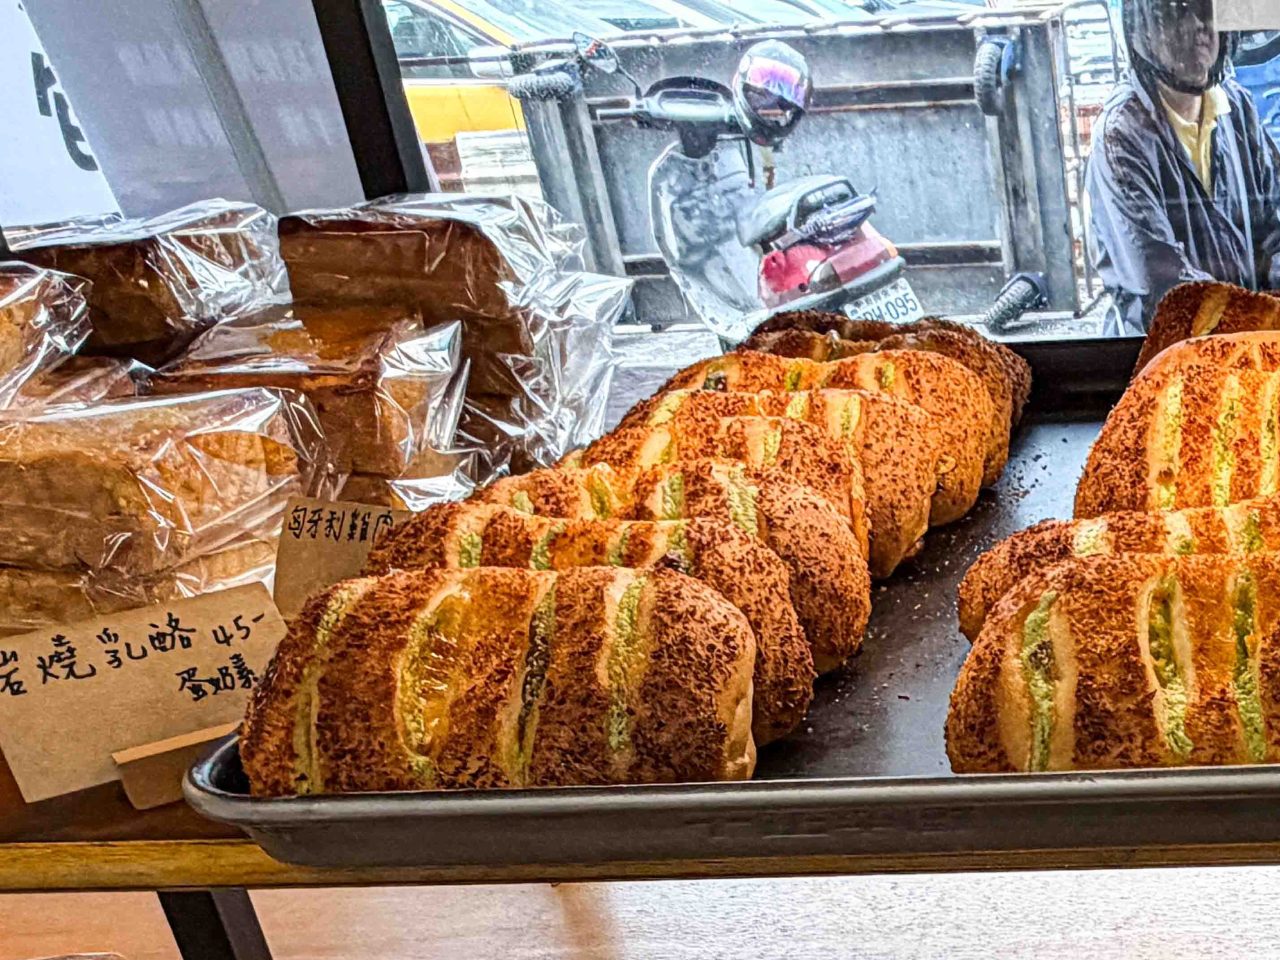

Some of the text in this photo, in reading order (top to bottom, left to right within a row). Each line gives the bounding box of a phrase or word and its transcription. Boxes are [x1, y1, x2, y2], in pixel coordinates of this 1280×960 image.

[0, 612, 196, 696] 岩燒乳酪
[176, 653, 259, 701] 蛋奶素
